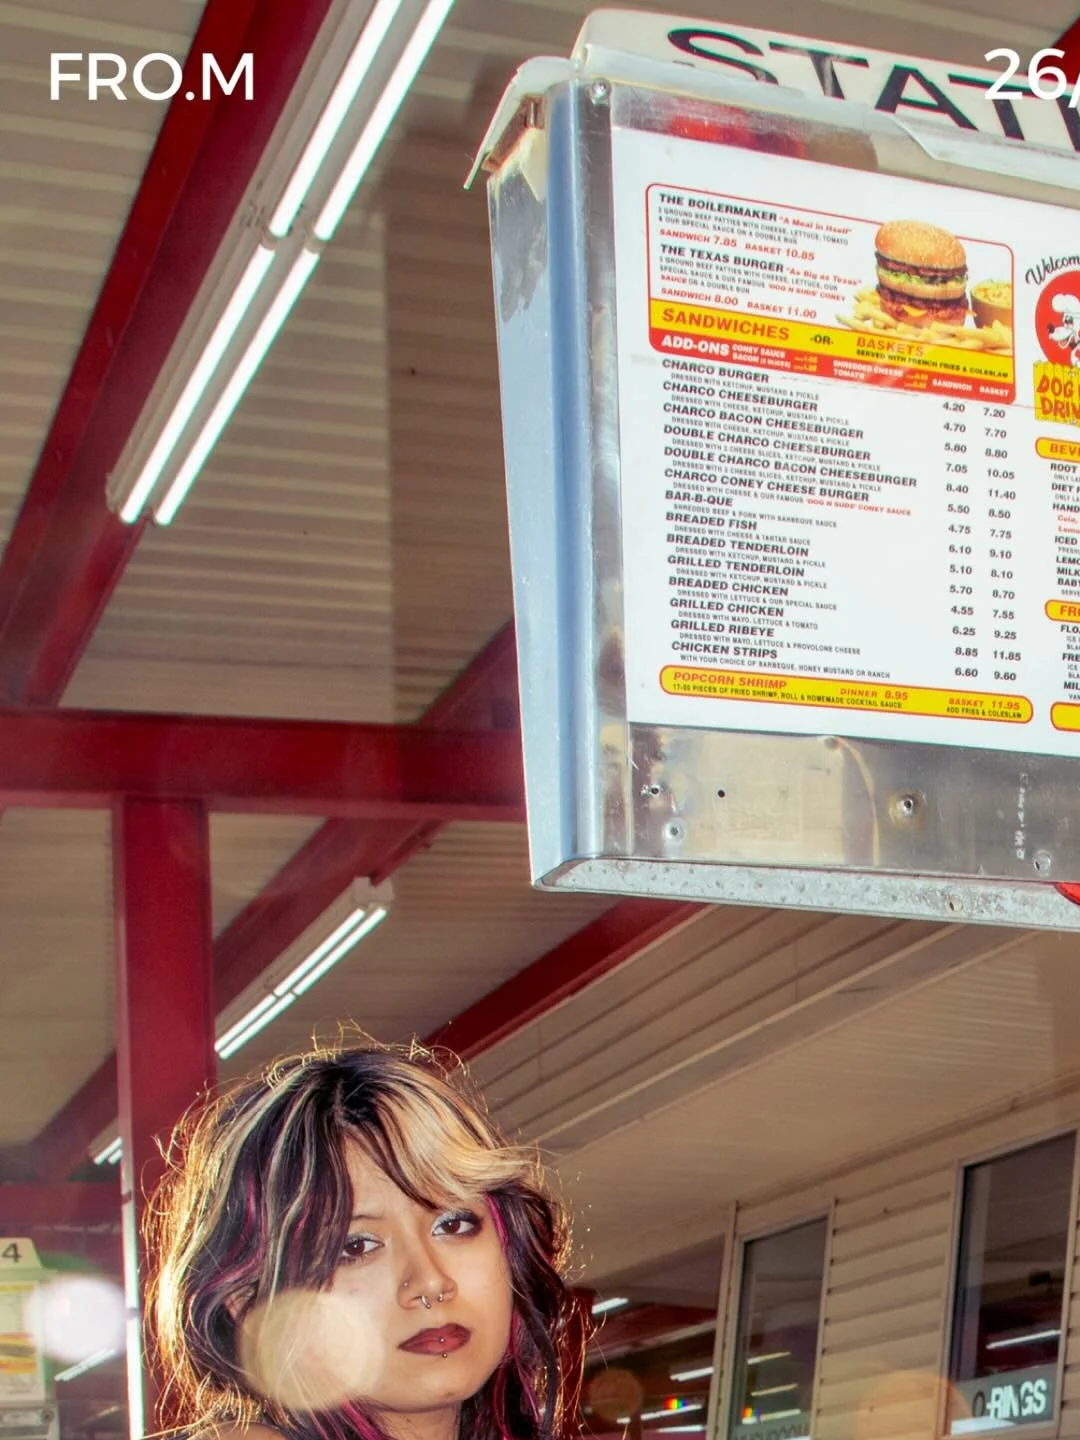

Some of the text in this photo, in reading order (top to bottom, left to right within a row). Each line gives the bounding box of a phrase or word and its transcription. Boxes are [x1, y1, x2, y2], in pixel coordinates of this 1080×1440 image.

[660, 193, 682, 205] THE
[688, 198, 776, 221] BOILERMAKER
[659, 228, 814, 260] SANDWICH 7.85 BASKET 10.85
[661, 244, 783, 272] THE TEXAS BURGER
[662, 308, 789, 340] SANDWICHES
[661, 334, 729, 356] ADD-ONS
[857, 337, 924, 358] BASKETS
[662, 358, 769, 383] CHARCO BURGER
[1036, 374, 1074, 396] DOG
[663, 381, 817, 411] CHARCO CHEESEBURGER
[942, 401, 1005, 418] 4.20 7.20
[663, 402, 863, 439] CHARCO BACON CHEESEBURGER
[664, 446, 917, 487] DOUBLE CHARCO BACON CHEESEBURGER
[1050, 462, 1077, 473] ROOT
[664, 468, 869, 501] CHARCO CONEY CHEESE BURGER
[665, 490, 732, 506] BAR-B-QUE
[665, 511, 757, 530] BREADED FISH
[1054, 535, 1077, 545] ICED
[667, 554, 804, 576] GRILLED TENDERLOIN
[949, 564, 1013, 579] 5.10 8.10
[1056, 567, 1080, 576] MILK
[668, 576, 788, 596] BREADED CHICKEN
[671, 619, 774, 637] GRILLED RIBEYE
[671, 641, 777, 659] CHICKEN STRIPS
[673, 671, 787, 689] POPCORN SHRIMP
